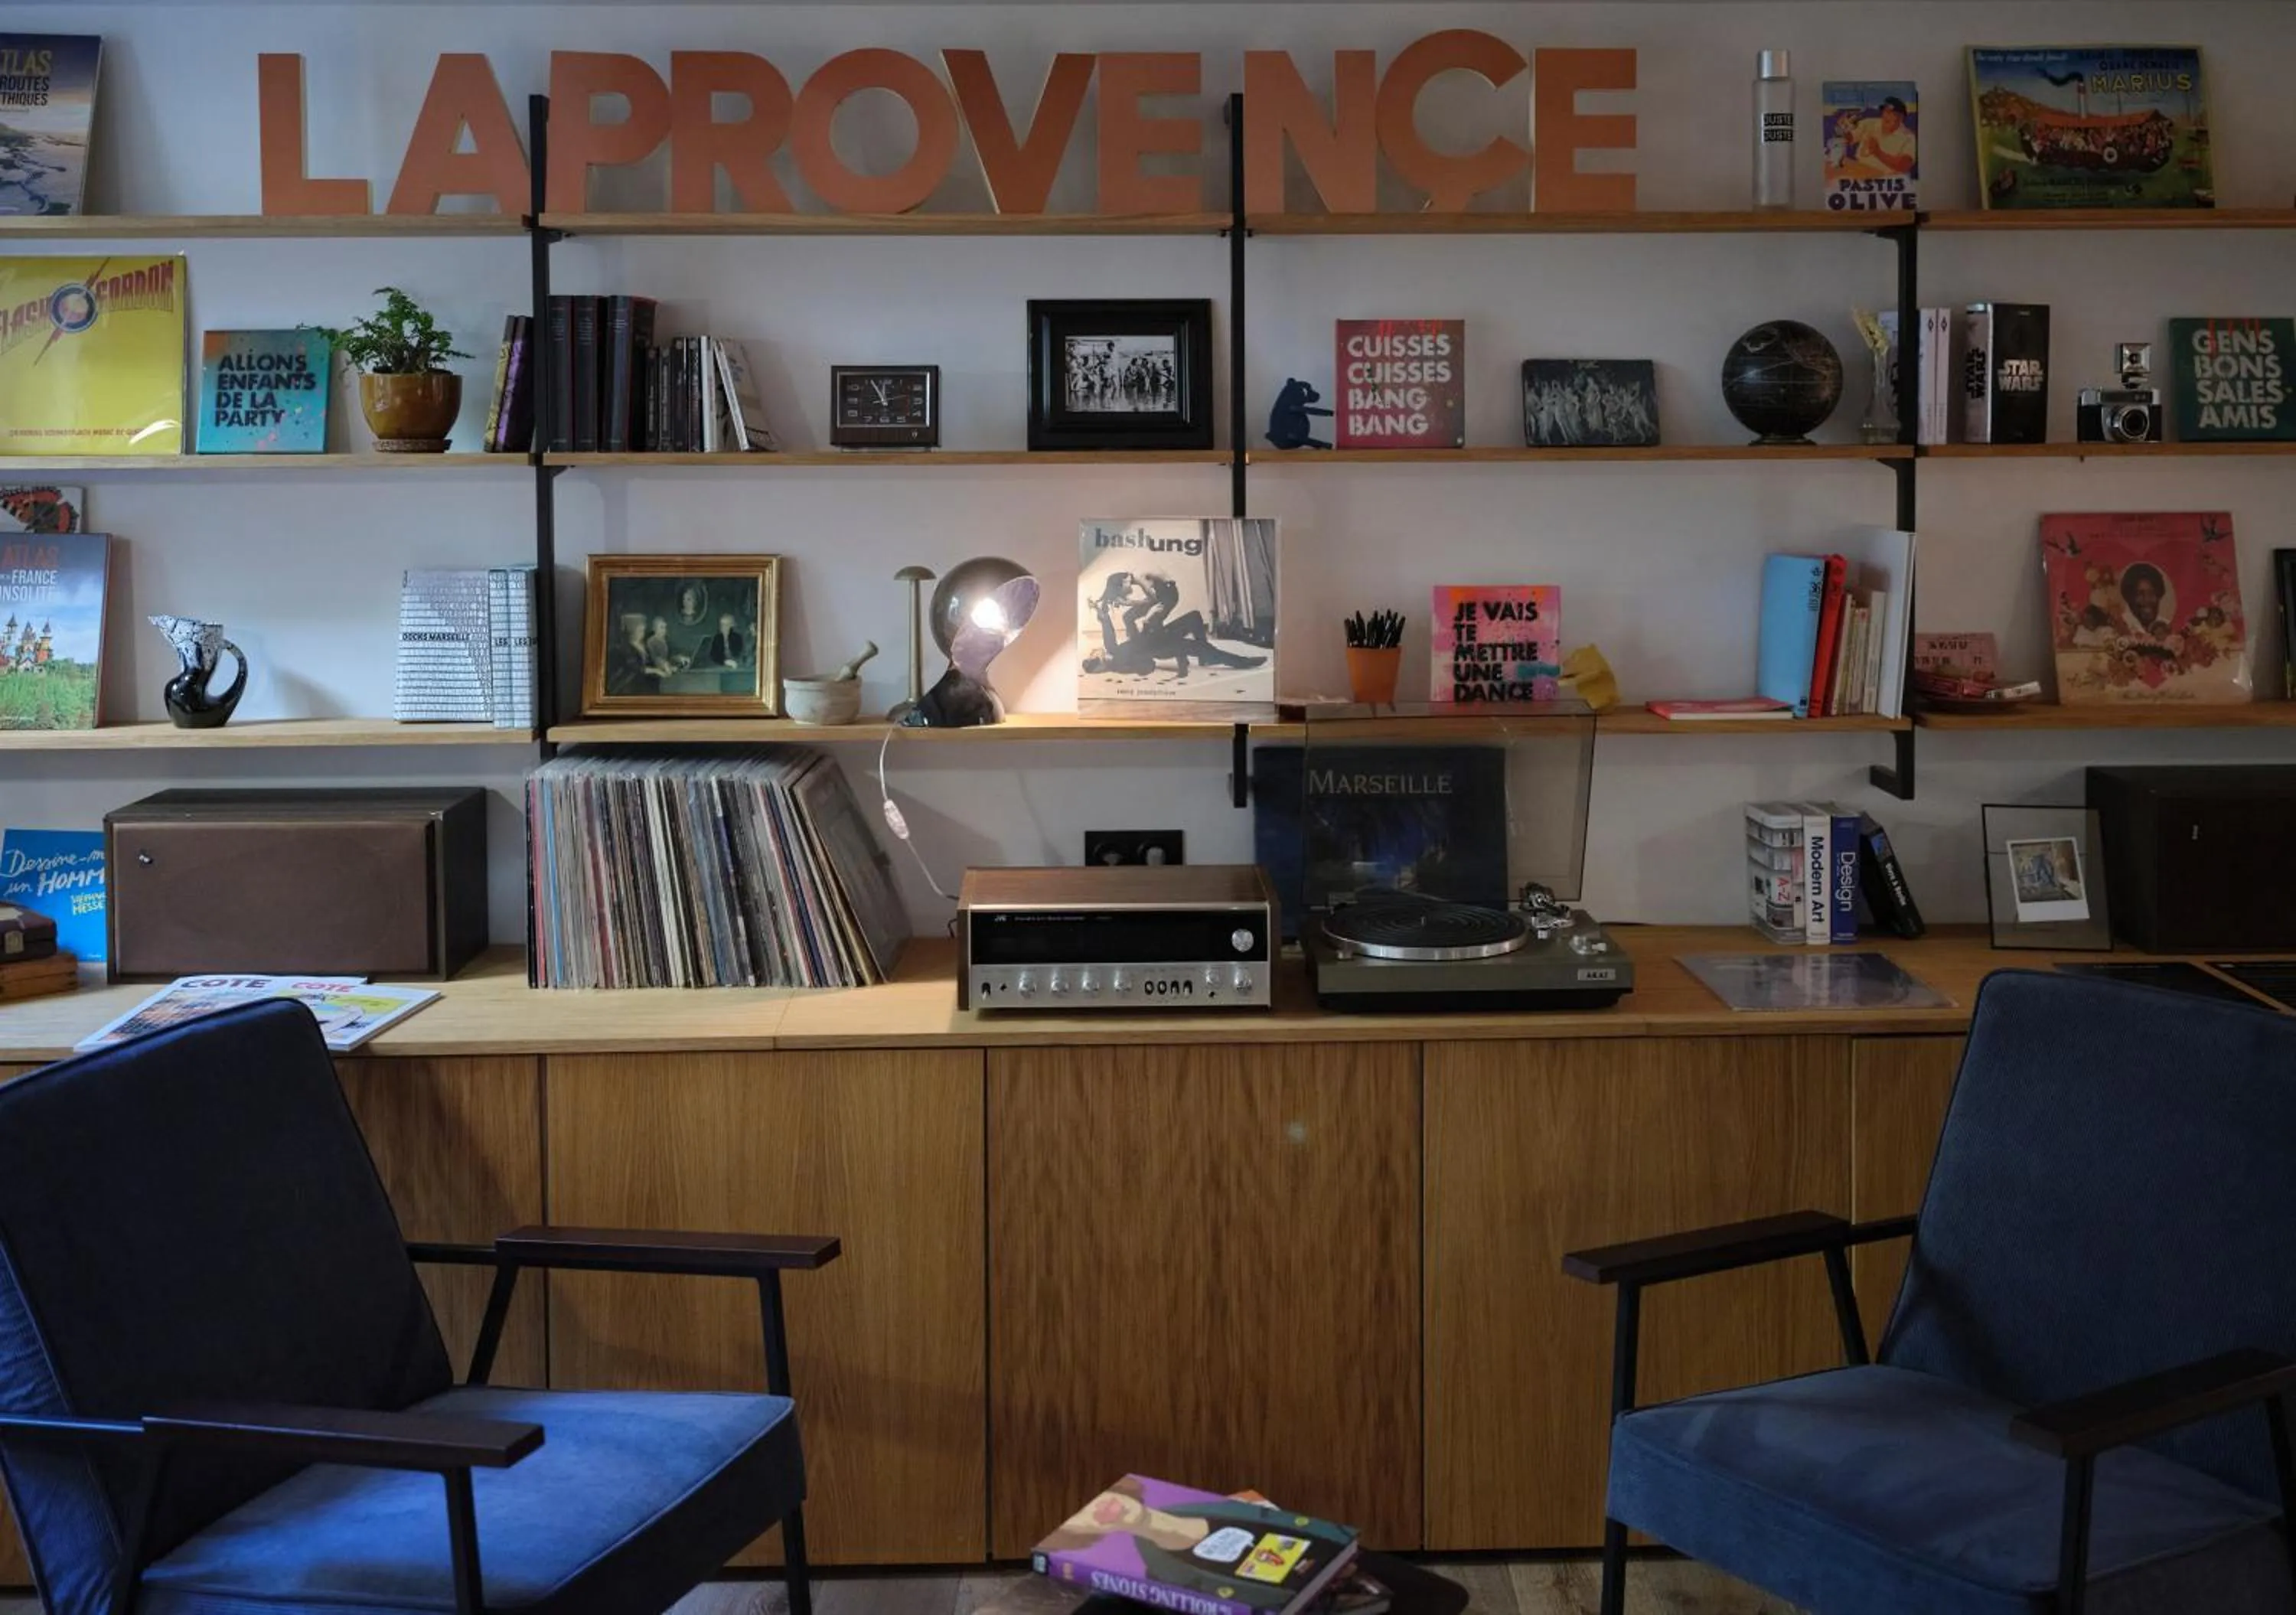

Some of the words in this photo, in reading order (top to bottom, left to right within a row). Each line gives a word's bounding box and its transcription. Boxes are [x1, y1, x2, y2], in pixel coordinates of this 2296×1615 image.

[0, 49, 52, 75] TLAS
[2091, 73, 2192, 93] MARIUS
[1840, 178, 1906, 191] PASTIS
[1828, 193, 1917, 210] OLIVE
[1348, 334, 1451, 357] CUISSES
[2192, 329, 2275, 355] GENS
[218, 354, 306, 372] ALLONS
[1348, 361, 1452, 384] CUISSES
[1998, 359, 2044, 377] STAR
[2195, 354, 2283, 380] BONS
[217, 372, 316, 390] ENFANTS
[1998, 375, 2044, 393] WARS
[216, 391, 243, 408] DE
[250, 391, 277, 408] LA
[1348, 389, 1427, 412] BANG
[2197, 380, 2285, 404] SALES
[215, 409, 285, 427] PARTY
[1348, 413, 1429, 436] BANG
[2198, 403, 2278, 429] AMIS
[1095, 527, 1202, 556] bashung
[11, 569, 58, 585] FRANCE
[1454, 602, 1476, 622] JE
[1483, 602, 1538, 622] VAIS
[1454, 624, 1476, 641] TE
[1454, 643, 1538, 661] METTRE
[1454, 664, 1502, 681] UNE
[1454, 683, 1534, 701] DANCE
[1309, 770, 1453, 794] MARSEILLE
[1811, 837, 1825, 896] Modern
[3, 882, 33, 896] un
[37, 867, 105, 897] HOMM
[1835, 851, 1855, 912] Design
[1812, 900, 1825, 923] Art
[181, 978, 272, 990] COTE
[1091, 1571, 1148, 1602] STONES
